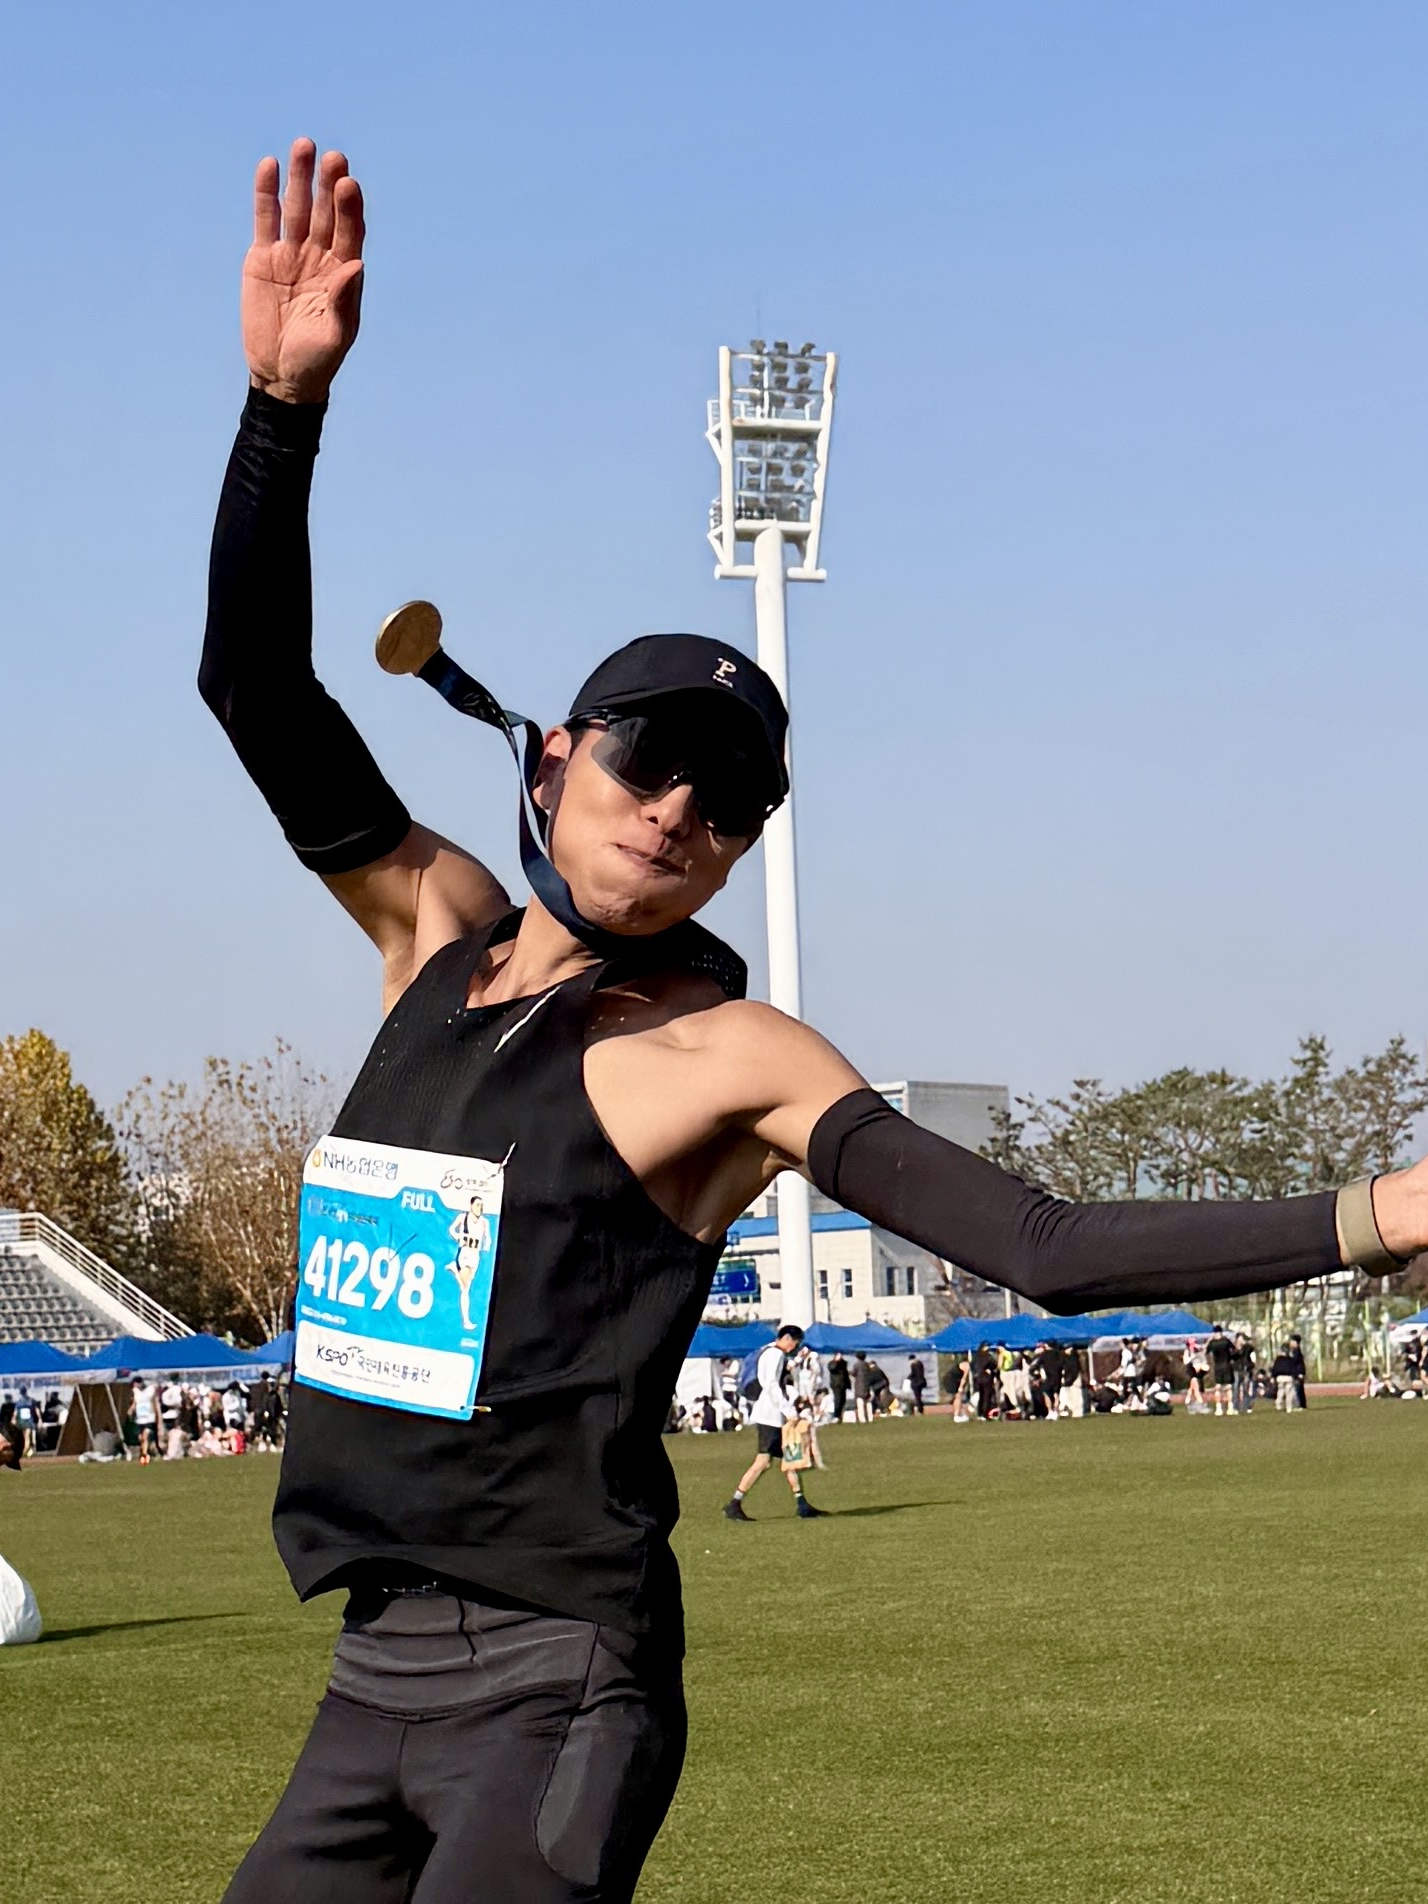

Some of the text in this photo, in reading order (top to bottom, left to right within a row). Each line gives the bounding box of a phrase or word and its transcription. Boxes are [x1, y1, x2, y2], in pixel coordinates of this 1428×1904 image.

[401, 1190, 437, 1214] FULL
[304, 1234, 436, 1320] 41298
[316, 1343, 349, 1367] KSPO
